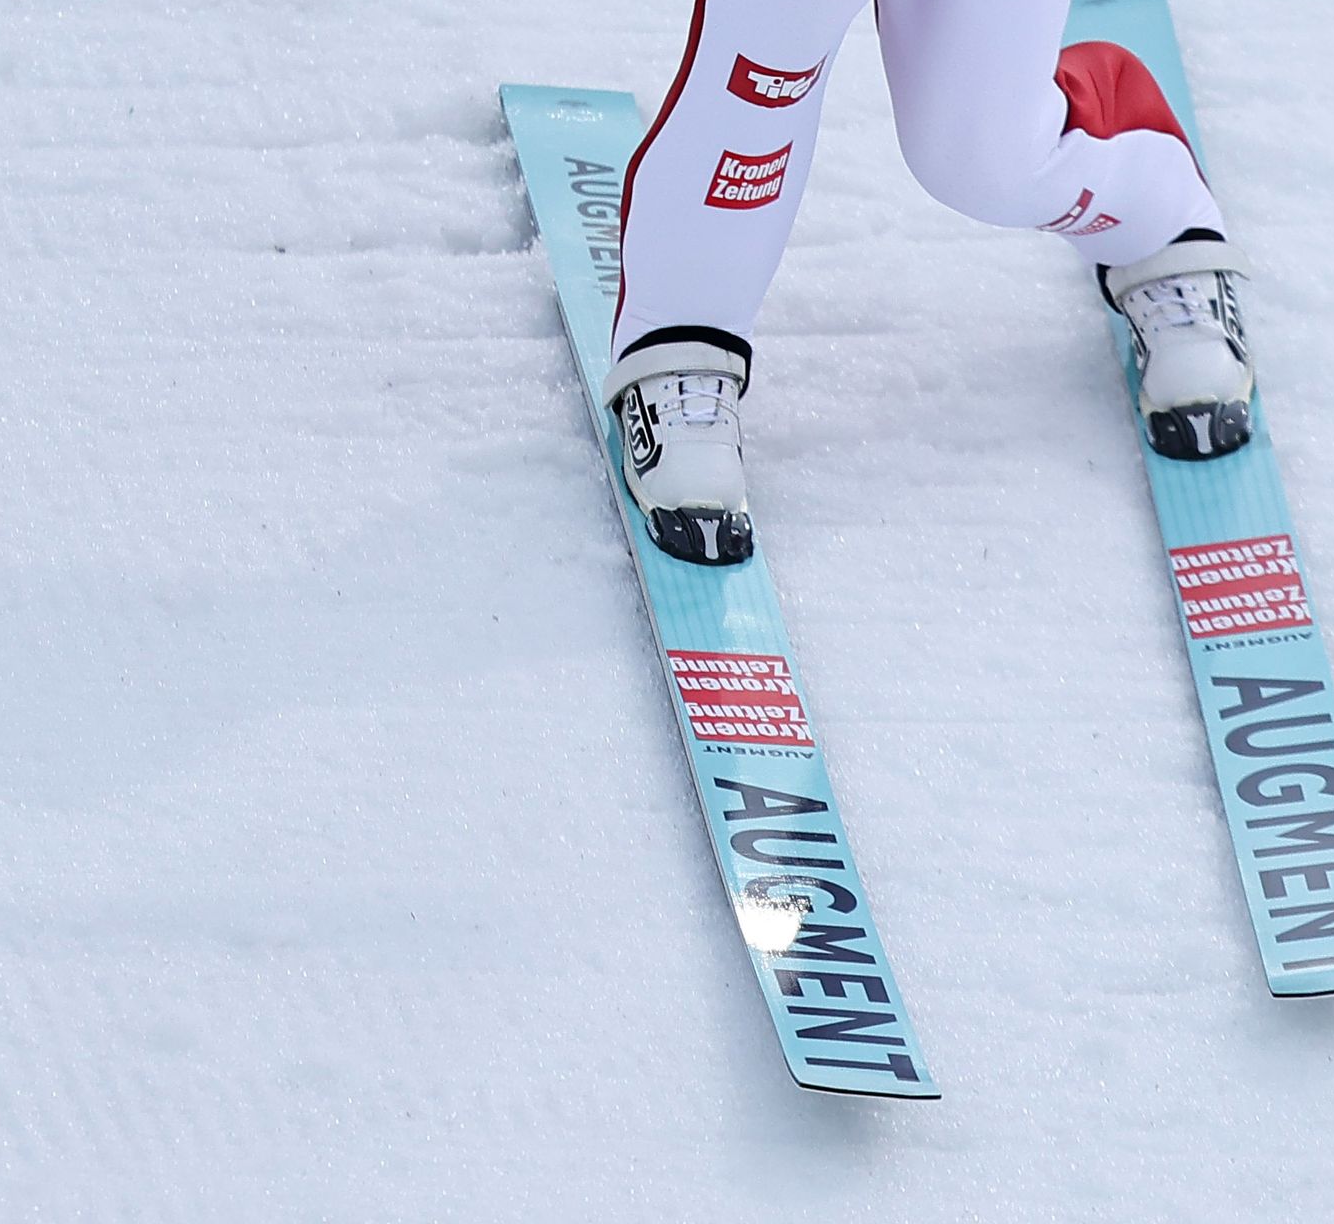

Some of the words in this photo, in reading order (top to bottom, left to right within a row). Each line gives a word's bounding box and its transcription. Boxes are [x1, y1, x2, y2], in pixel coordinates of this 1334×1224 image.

[720, 152, 788, 180] Kronen
[712, 176, 781, 201] Zeitung
[1171, 539, 1295, 570] Zeitung
[1176, 557, 1299, 588] Kronen
[1182, 585, 1307, 616] Zeitung
[1188, 602, 1311, 633] Kronen
[1203, 632, 1312, 652] AUGMENT
[669, 657, 790, 676] Zeitung
[677, 677, 798, 695] Kronen
[685, 702, 806, 721] Zeitung
[692, 722, 813, 740] Kronen
[703, 746, 814, 760] AUGMENT
